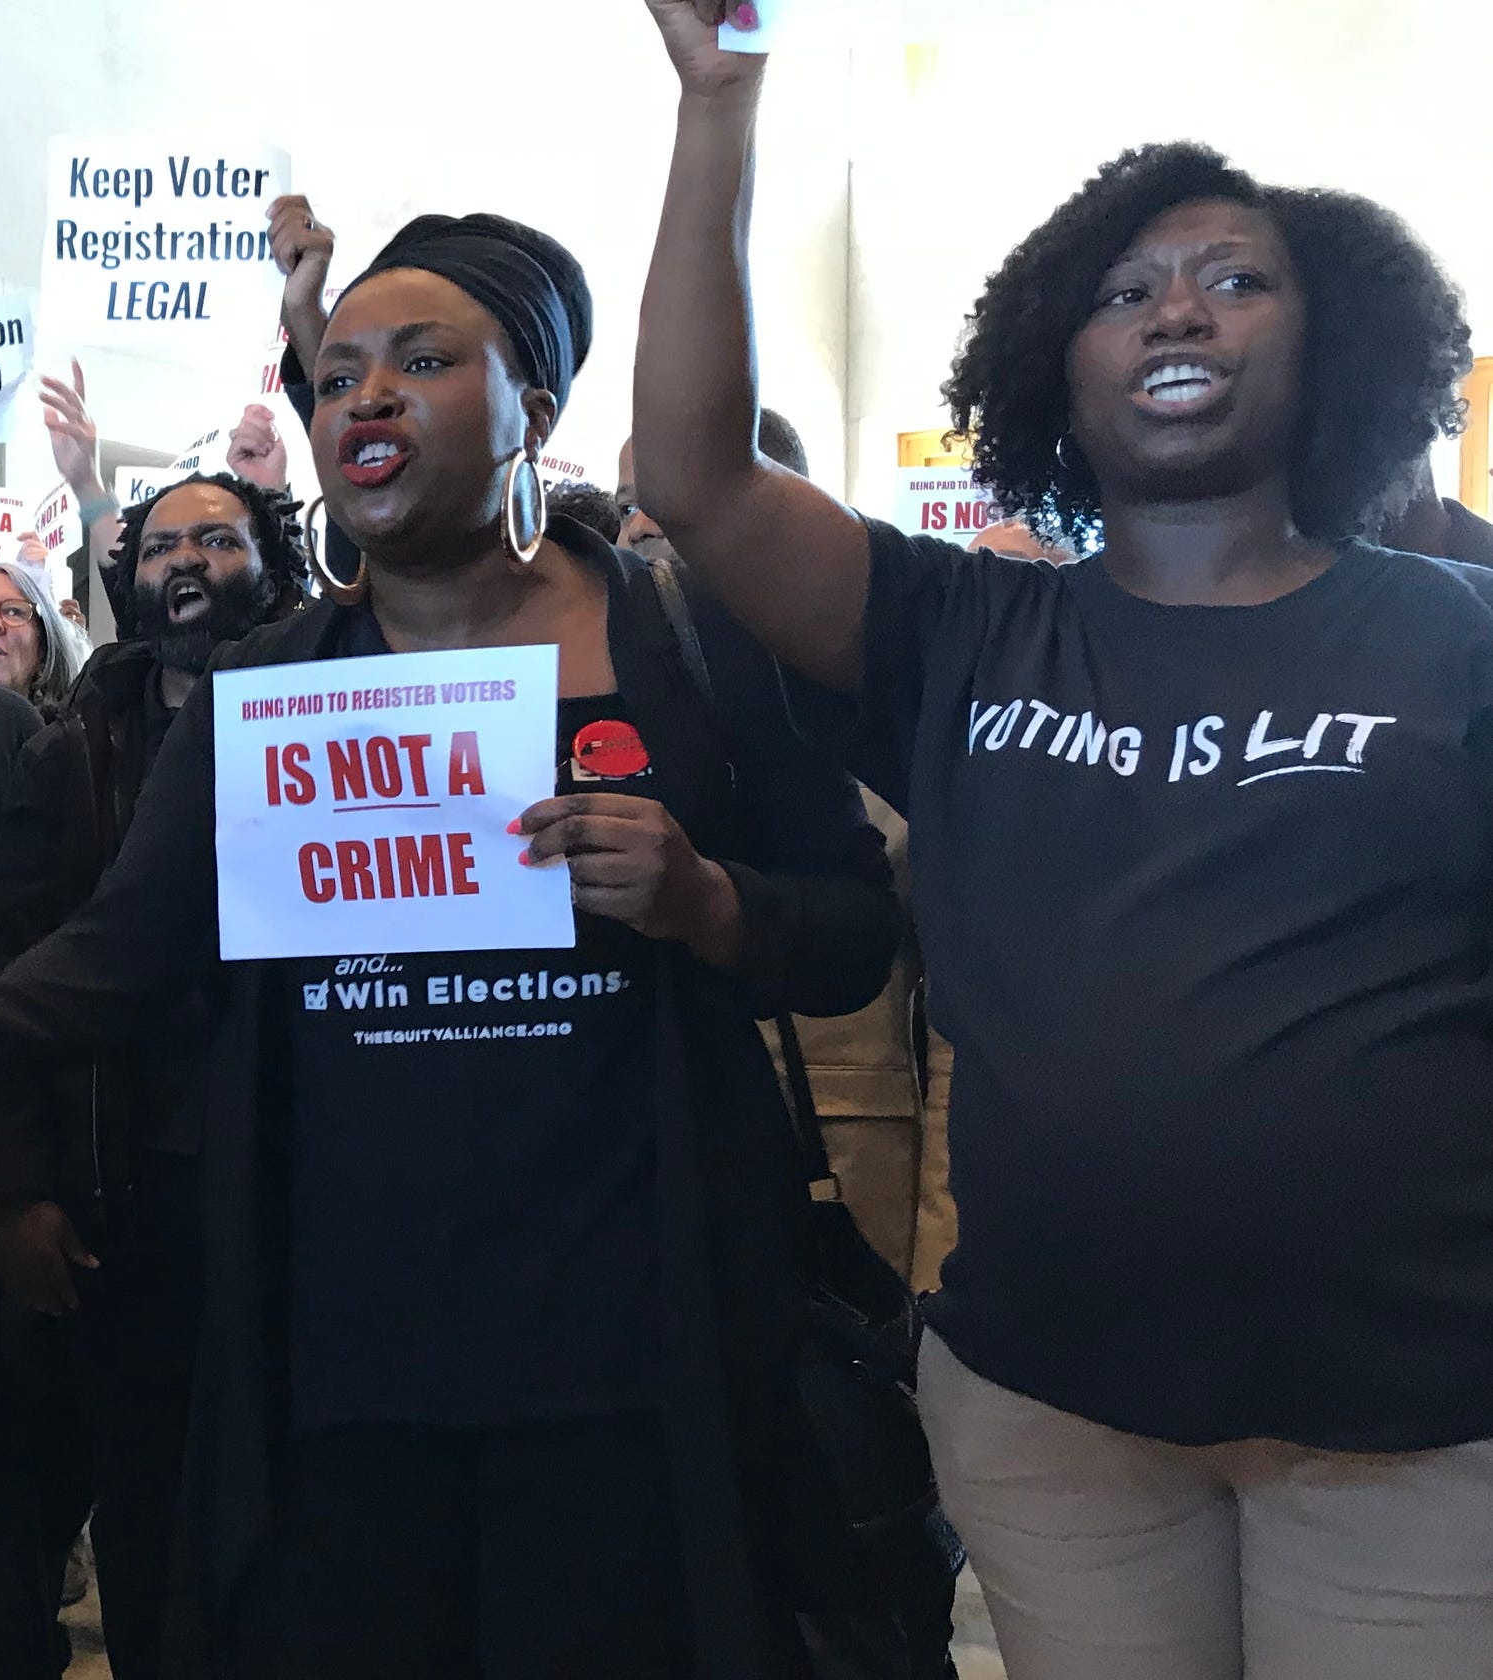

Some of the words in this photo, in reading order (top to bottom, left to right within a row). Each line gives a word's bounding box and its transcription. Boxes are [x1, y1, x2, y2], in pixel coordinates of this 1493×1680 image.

[70, 156, 153, 208] Keep
[168, 155, 270, 199] Voter
[107, 281, 210, 321] LEGAL
[541, 455, 584, 478] HB1079
[910, 481, 934, 490] BEING
[936, 481, 955, 490] PAID
[958, 480, 967, 489] TO
[0, 512, 12, 532] A
[41, 499, 58, 530] NOT
[60, 494, 68, 513] A
[921, 501, 947, 530] IS
[954, 501, 988, 529] NO
[44, 525, 64, 550] IME
[242, 698, 284, 721] BEING
[287, 693, 323, 717] PAID
[327, 692, 347, 713] TO
[351, 684, 436, 711] REGISTER
[440, 679, 516, 705] VOTERS
[967, 699, 1142, 776] VOTING
[1168, 715, 1225, 783] IS
[1243, 709, 1397, 764] LIT
[265, 742, 317, 807] IS
[326, 734, 432, 802] NOT
[448, 731, 486, 796] A
[298, 832, 480, 904] CRIME
[334, 954, 403, 975] and...
[335, 978, 408, 1009] Win
[353, 1022, 572, 1045] THEEQUITYALLIANCE.ORG
